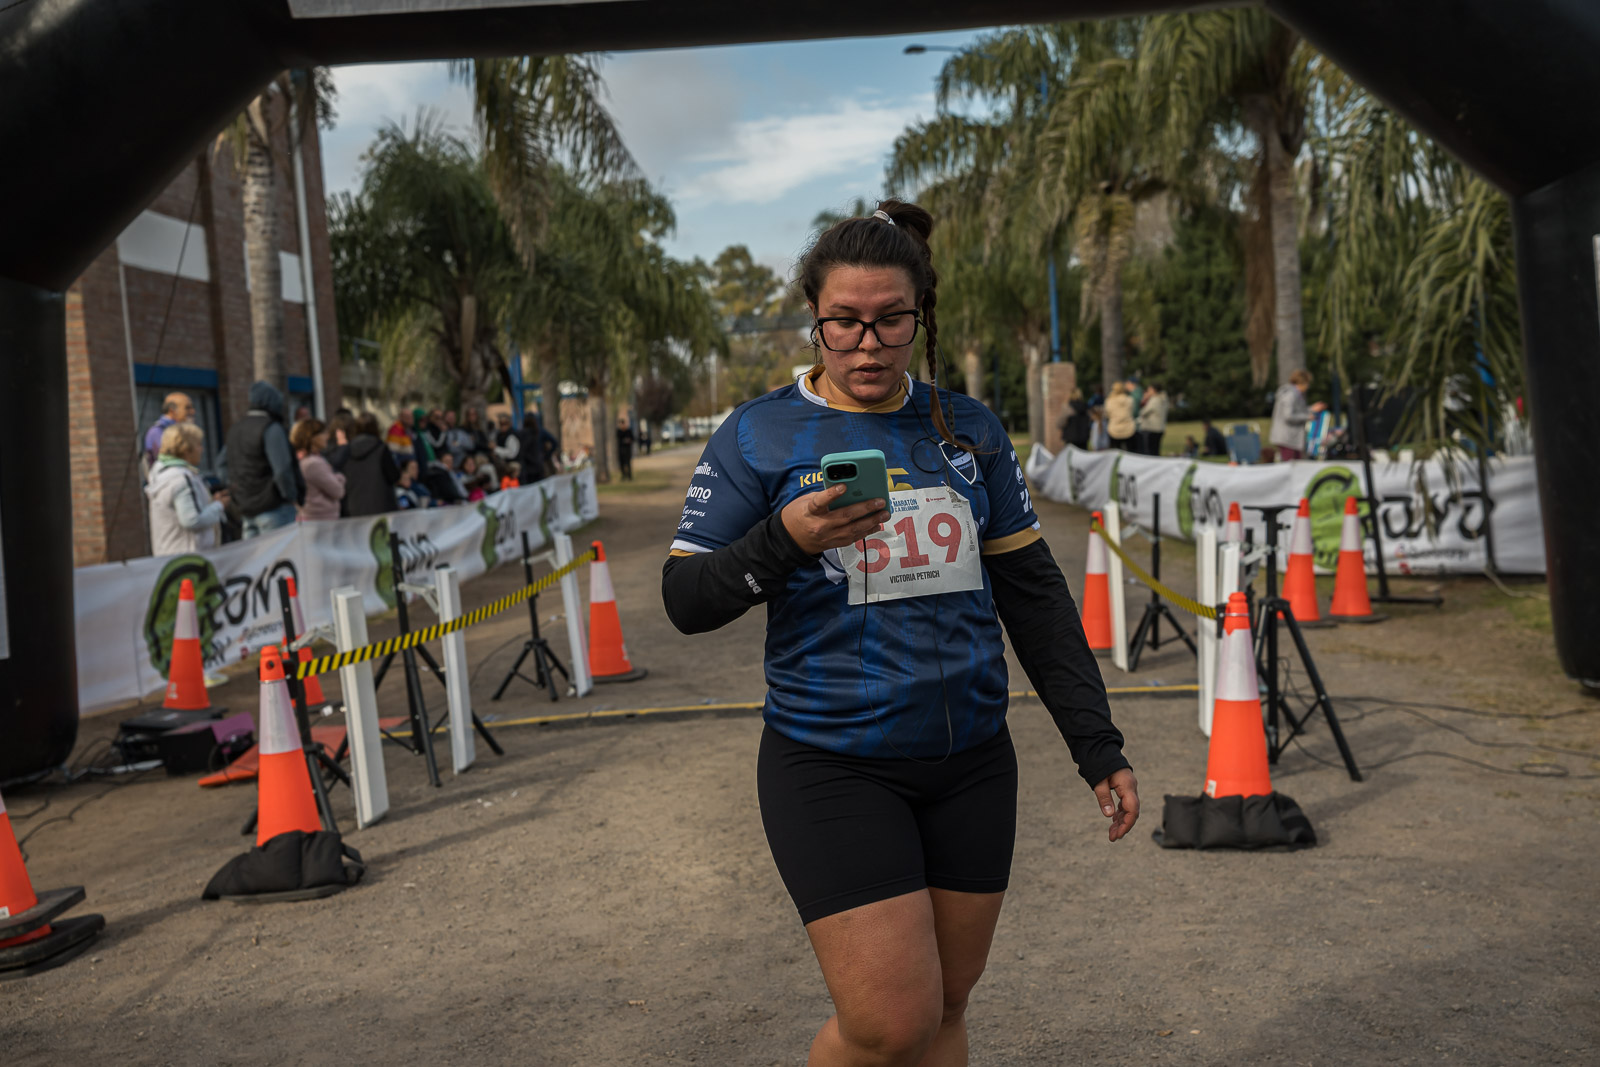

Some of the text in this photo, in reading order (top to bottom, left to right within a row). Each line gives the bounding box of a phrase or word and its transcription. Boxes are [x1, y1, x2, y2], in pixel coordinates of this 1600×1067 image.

[892, 497, 919, 507] MARATÓN
[854, 512, 962, 574] 519
[889, 569, 941, 584] VICTORIA PETRICH
